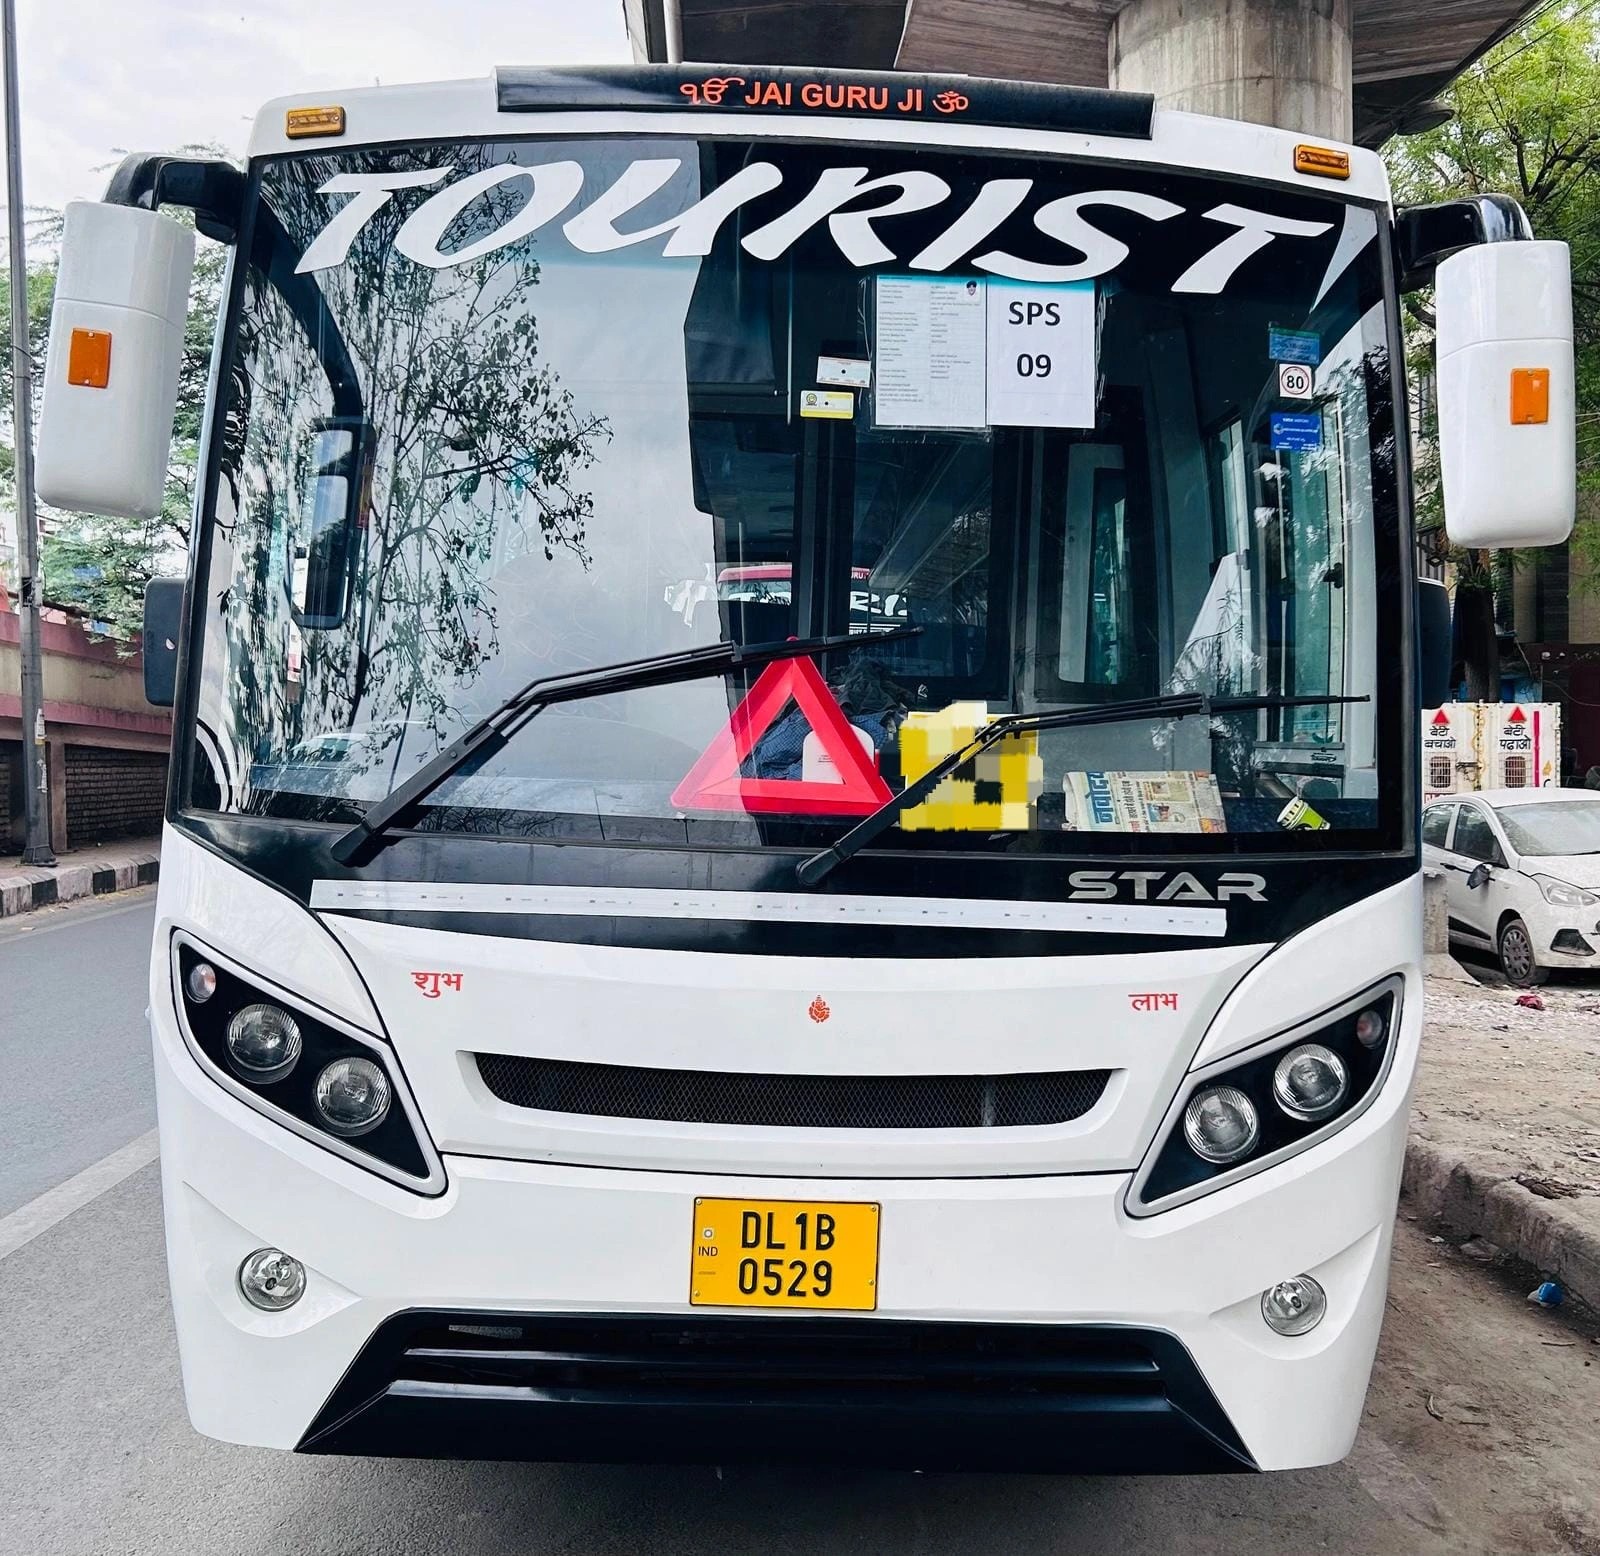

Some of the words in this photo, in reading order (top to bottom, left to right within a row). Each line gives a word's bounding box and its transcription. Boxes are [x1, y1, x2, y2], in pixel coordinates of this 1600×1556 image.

[745, 82, 792, 106] JAI
[801, 84, 888, 111] GURU
[898, 88, 923, 112] JI
[294, 158, 1335, 294] TOURIST
[1008, 301, 1061, 326] SPS
[1016, 353, 1052, 378] 09
[1286, 375, 1304, 389] 80
[1067, 870, 1269, 902] STAR
[410, 971, 464, 999] शुभ
[1127, 993, 1179, 1011] लाभ
[698, 1246, 718, 1257] IND
[738, 1257, 833, 1298] 0529
